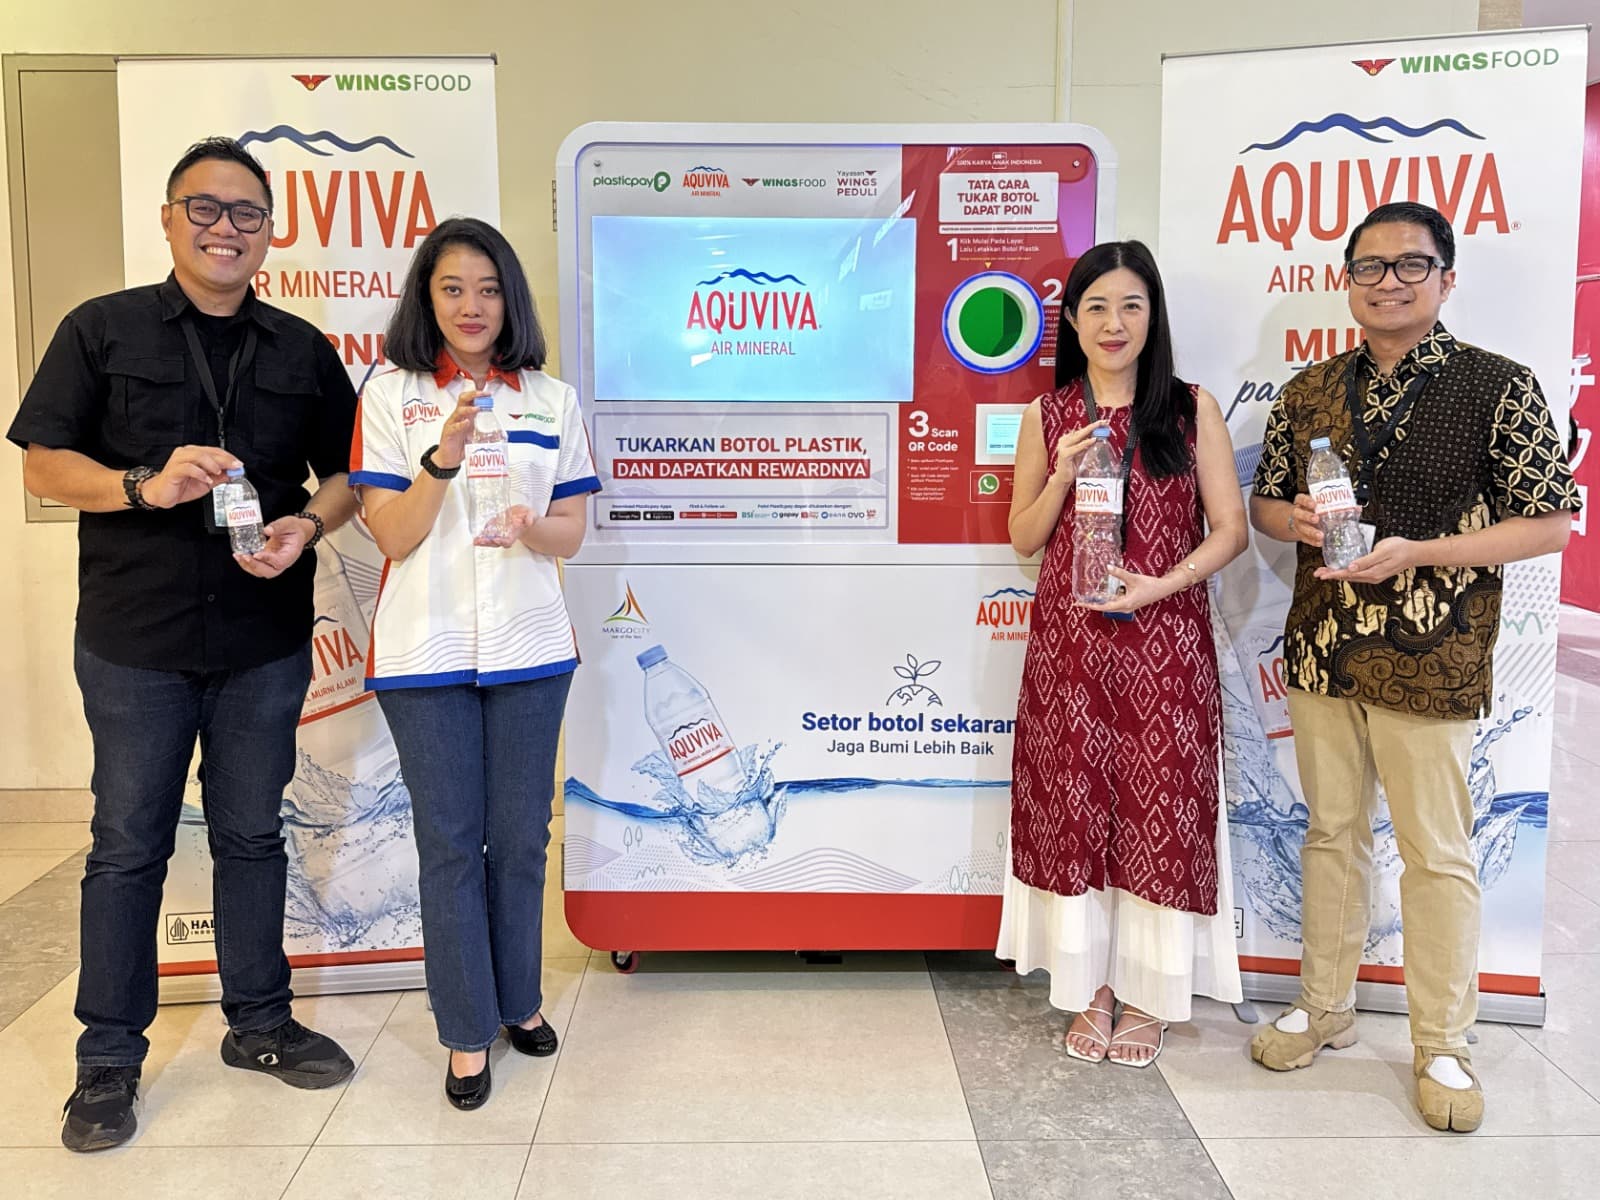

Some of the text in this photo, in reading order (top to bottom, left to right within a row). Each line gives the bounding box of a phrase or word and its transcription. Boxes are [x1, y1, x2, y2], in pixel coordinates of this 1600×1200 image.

[1400, 48, 1559, 74] WINGSFOOD
[335, 74, 471, 91] WINGSFOOD
[593, 176, 654, 188] plasticpay
[682, 173, 730, 189] AQUVIVA
[762, 178, 827, 188] WINGSFOOD
[837, 178, 878, 187] WINGS
[968, 180, 1030, 190] TATA CARA
[837, 188, 877, 197] PEDULI
[957, 193, 1040, 203] TUKAR BOTOL
[265, 170, 438, 249] UVIVA
[964, 205, 1033, 216] DAPAT POIN
[946, 238, 959, 262] 1
[281, 270, 401, 298] MINERAL
[1267, 264, 1315, 293] AIR
[1042, 278, 1062, 306] 2
[686, 290, 818, 335] AQUVIVA
[711, 341, 796, 355] AIR MINERAL
[402, 404, 441, 420] QUVIVA
[908, 410, 959, 438] 3 Scan
[615, 437, 867, 455] TUKARKAN BOTOL PLASTIK,
[908, 441, 958, 452] QR Code
[617, 462, 866, 477] DAN DAPATKAN REWARDNYA
[976, 601, 1035, 628] AQUVI
[992, 632, 1030, 641] AIR MINE
[802, 712, 1016, 734] Setor botol sekaran
[668, 722, 723, 761] AQUVIVA
[826, 739, 995, 756] Jaga Bumi Lebih Baik
